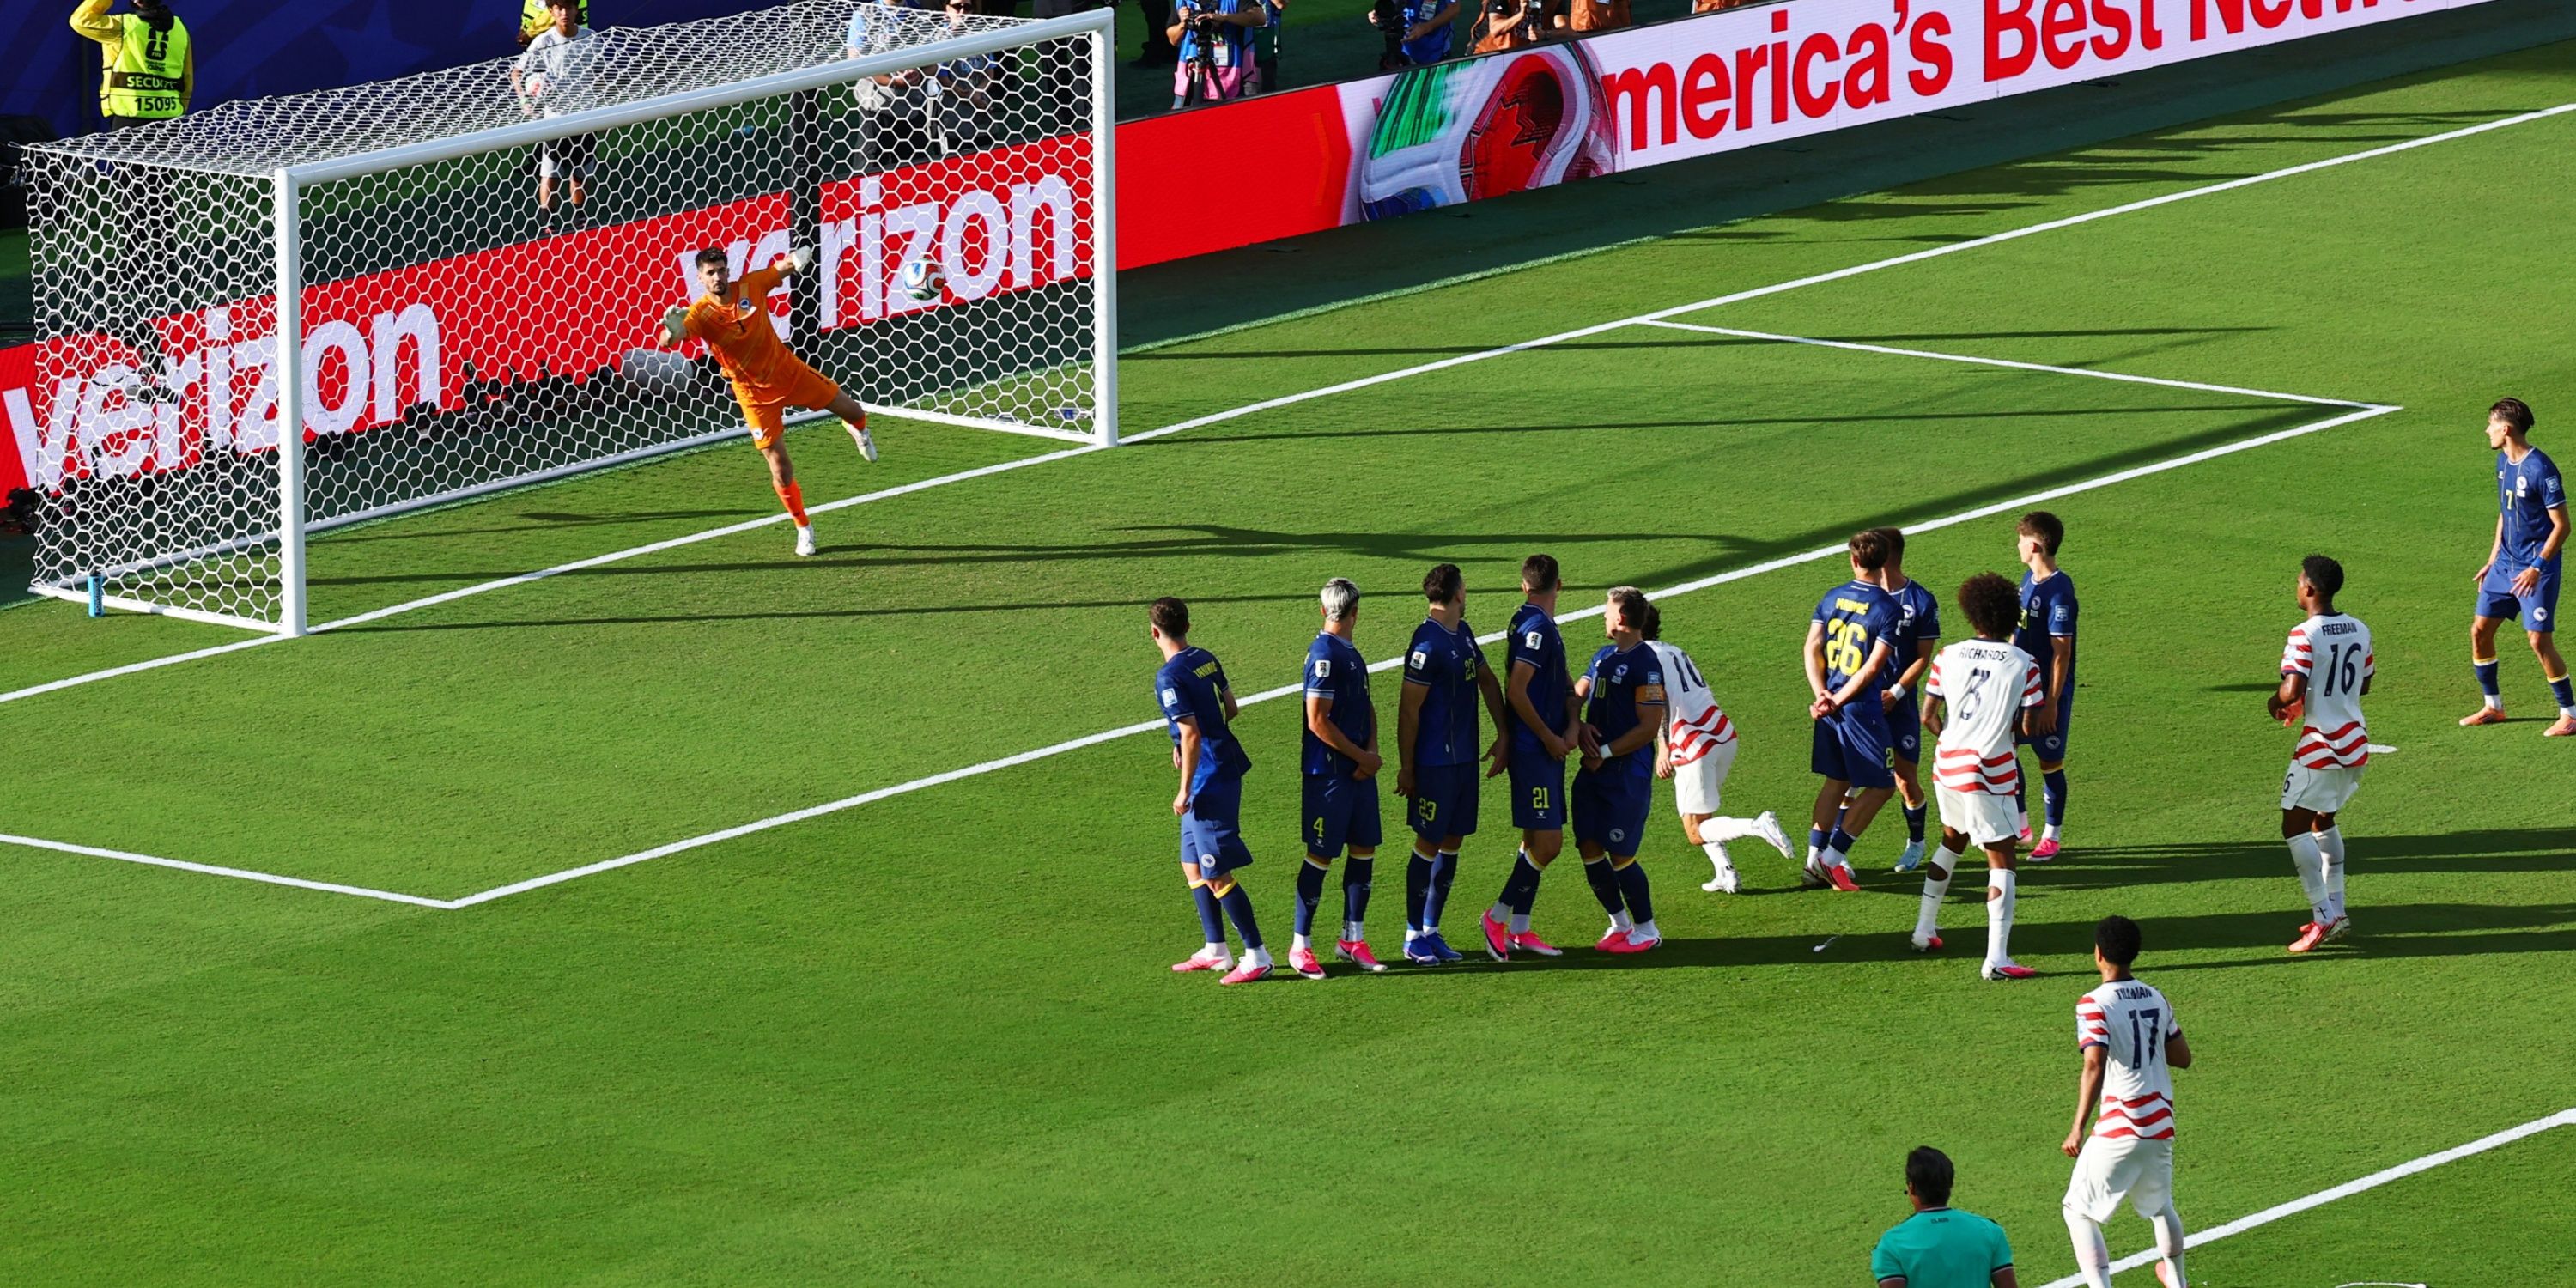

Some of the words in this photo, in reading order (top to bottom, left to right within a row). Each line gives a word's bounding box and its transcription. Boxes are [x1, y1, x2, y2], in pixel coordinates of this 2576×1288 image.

[1601, 0, 1953, 151] merica's
[135, 96, 177, 112] 15095
[2, 303, 441, 493] verizon
[2506, 489, 2513, 510] 7
[2322, 622, 2357, 636] FREEMAN
[1826, 617, 1867, 677] 26
[1464, 658, 1477, 681] 23
[2324, 642, 2361, 696] 16
[1595, 677, 1607, 699] 10
[1885, 747, 1895, 768] 2
[2283, 773, 2294, 793] 6
[1532, 787, 1550, 809] 21
[1419, 797, 1437, 822] 23
[1313, 817, 1323, 838] 4
[2114, 985, 2153, 1000] TILLMAN
[2128, 1007, 2160, 1070] 17
